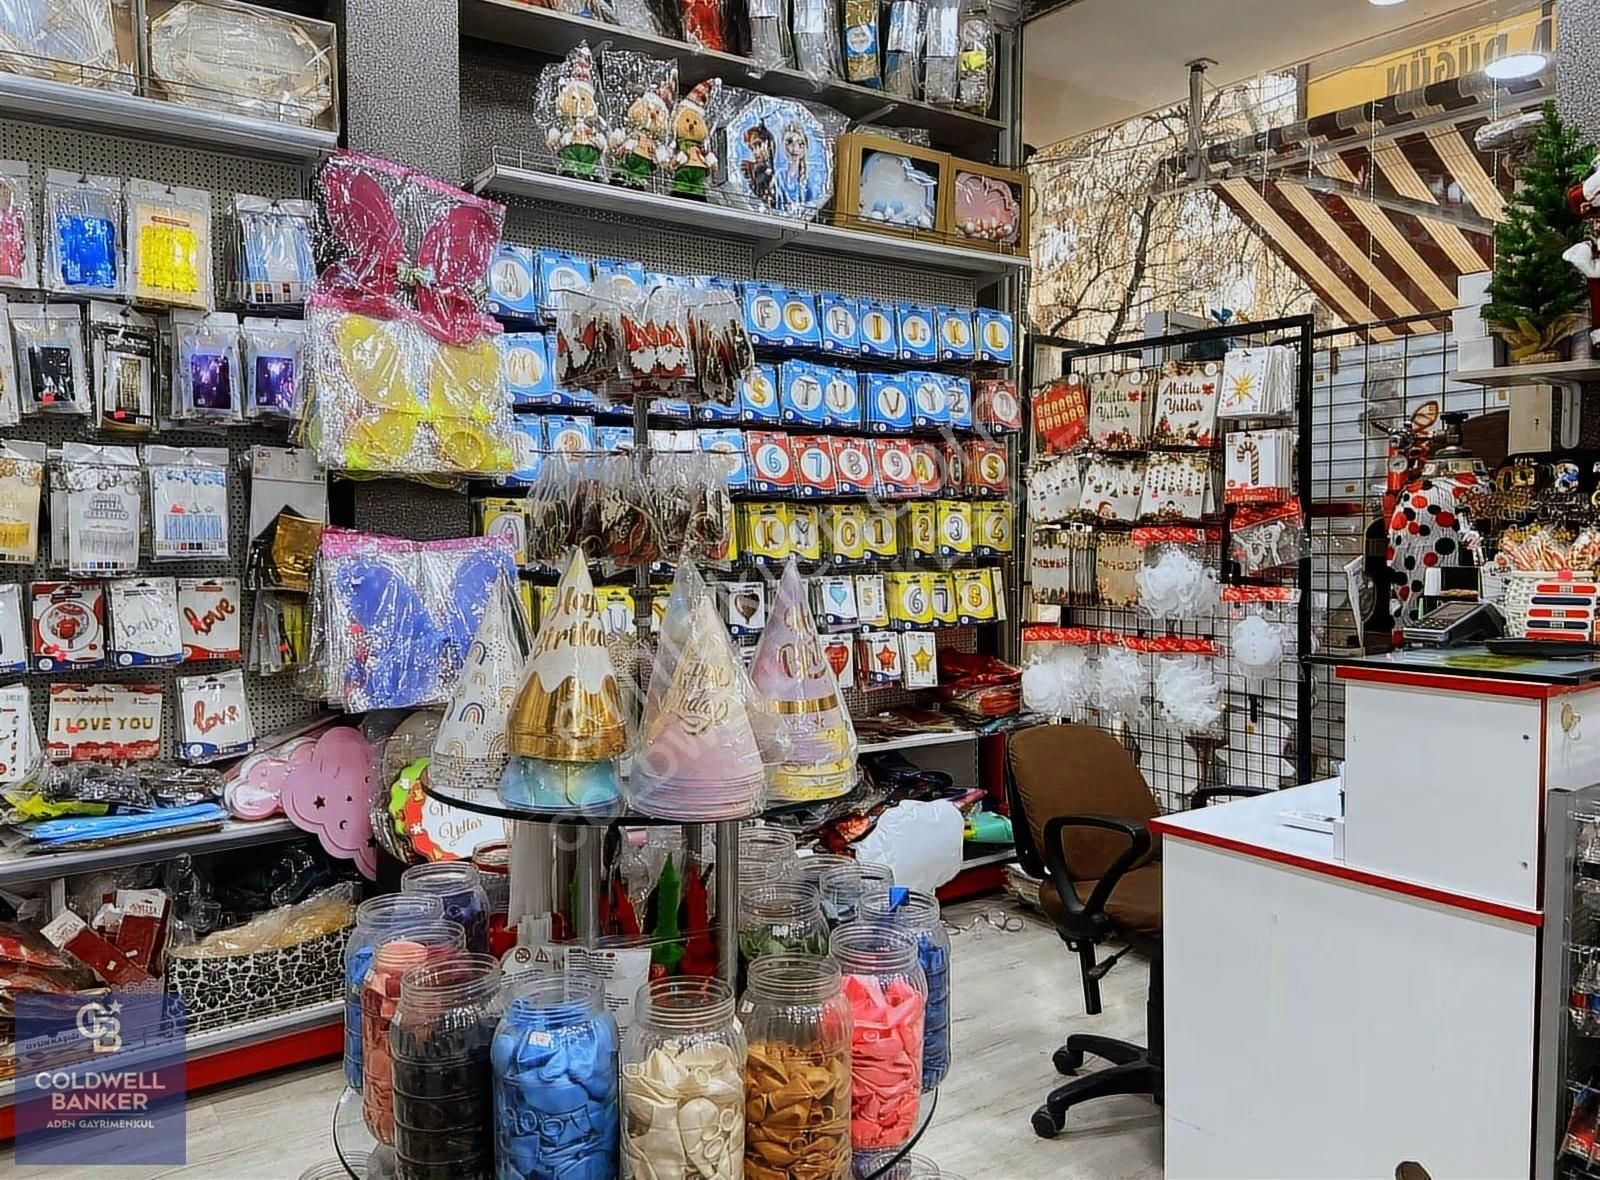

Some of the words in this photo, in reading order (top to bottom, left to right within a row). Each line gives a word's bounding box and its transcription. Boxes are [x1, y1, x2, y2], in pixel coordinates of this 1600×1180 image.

[1095, 390, 1128, 404] Mutlu
[1163, 380, 1200, 396] Mutlu
[765, 447, 781, 474] 6
[808, 452, 822, 478] 7
[872, 517, 884, 545] 1
[918, 516, 930, 542] 2
[948, 515, 963, 541] 3
[908, 587, 924, 614] 6
[934, 587, 948, 612] 7
[66, 717, 112, 732] LOVE
[117, 717, 154, 730] YOU
